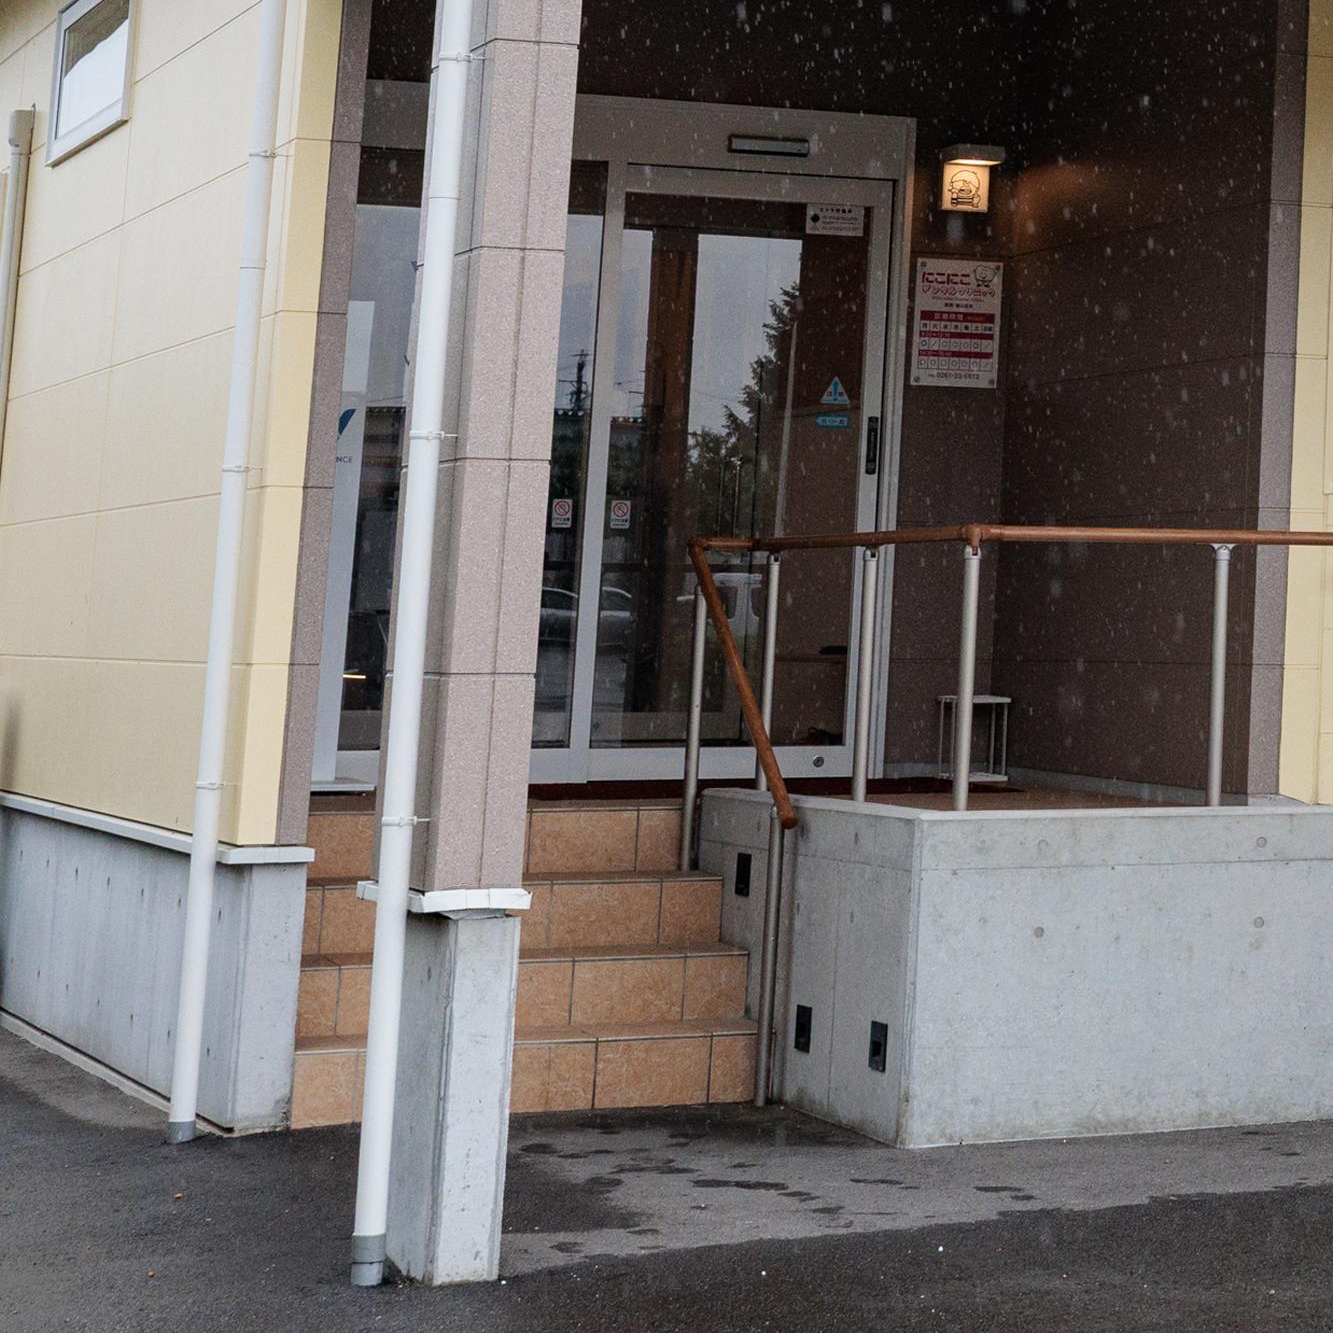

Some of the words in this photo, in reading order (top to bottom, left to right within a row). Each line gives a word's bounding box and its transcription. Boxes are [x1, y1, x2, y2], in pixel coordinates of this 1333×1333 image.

[922, 271, 971, 286] にこにこ
[336, 456, 353, 464] NCE
